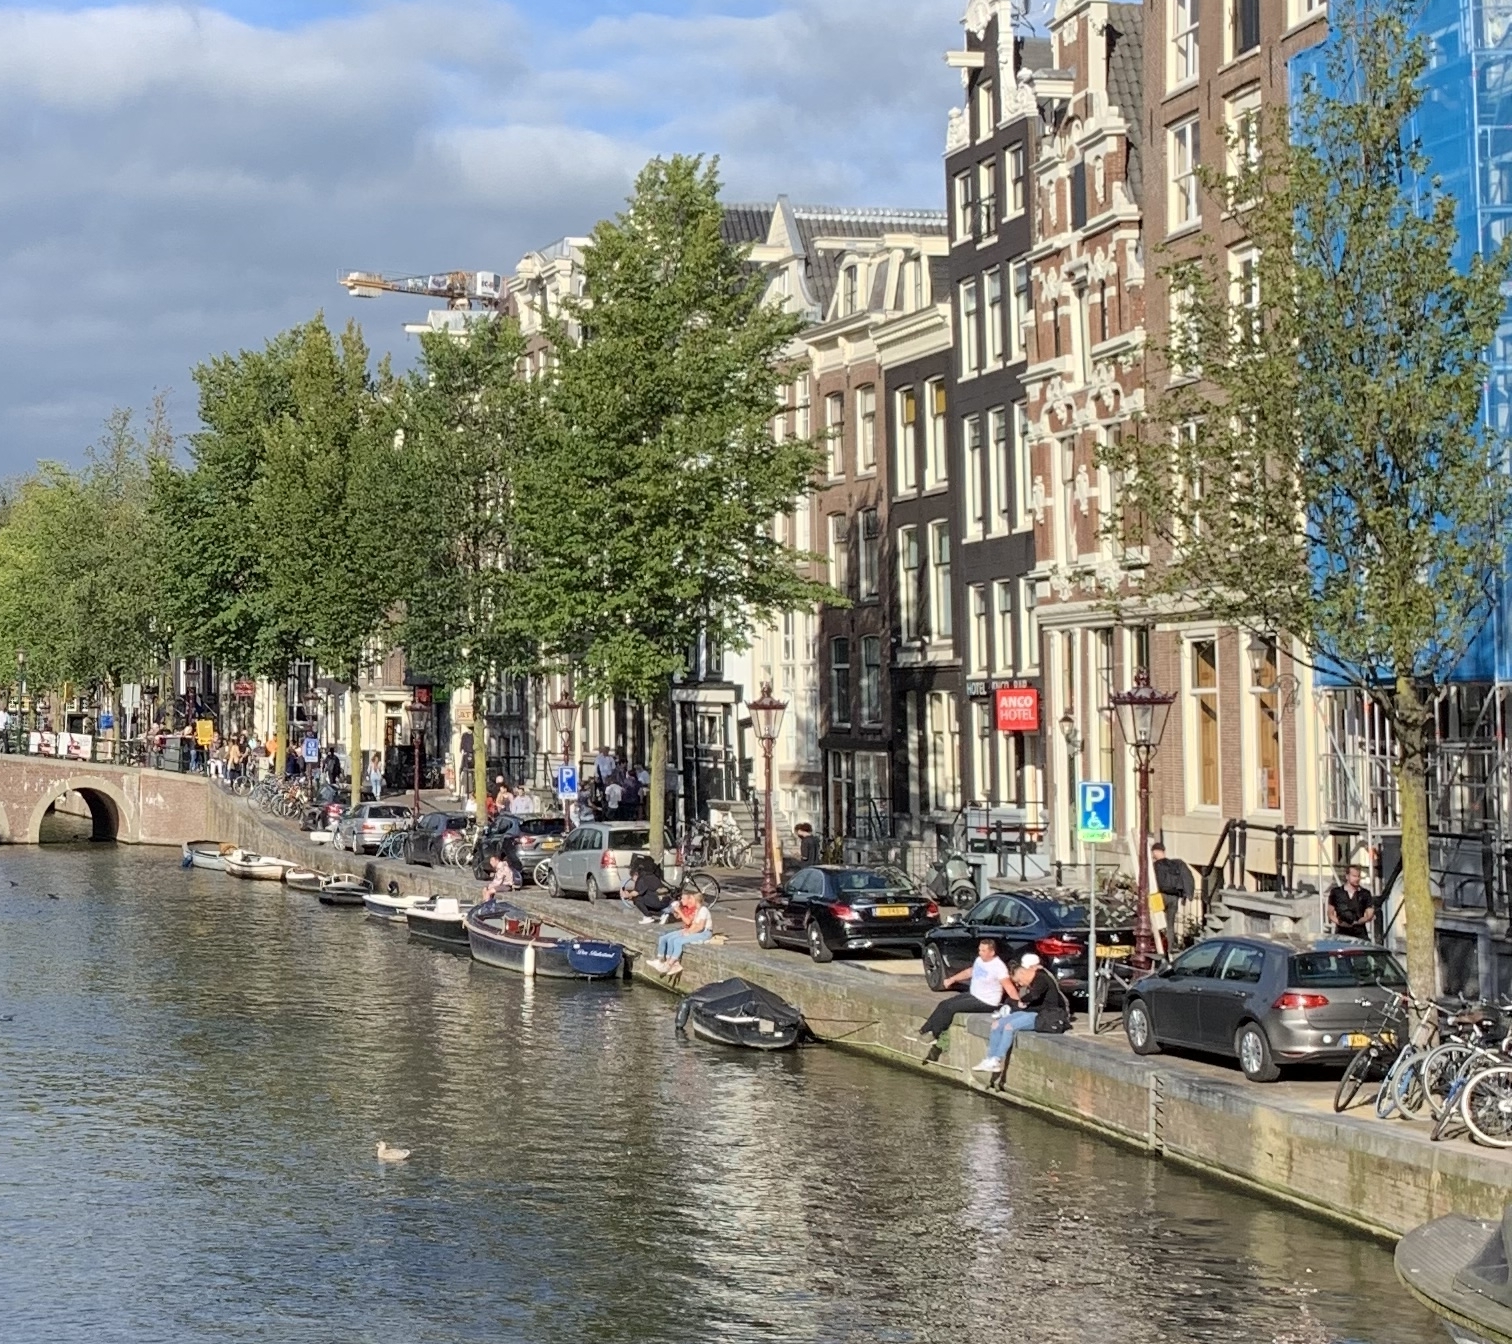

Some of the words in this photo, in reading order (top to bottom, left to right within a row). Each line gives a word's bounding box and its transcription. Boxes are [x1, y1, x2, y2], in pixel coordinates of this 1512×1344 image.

[966, 681, 987, 695] HOTEL
[1000, 696, 1033, 708] ANCO
[1000, 708, 1033, 721] HOTEL
[562, 768, 573, 783] P
[1085, 786, 1105, 812] P
